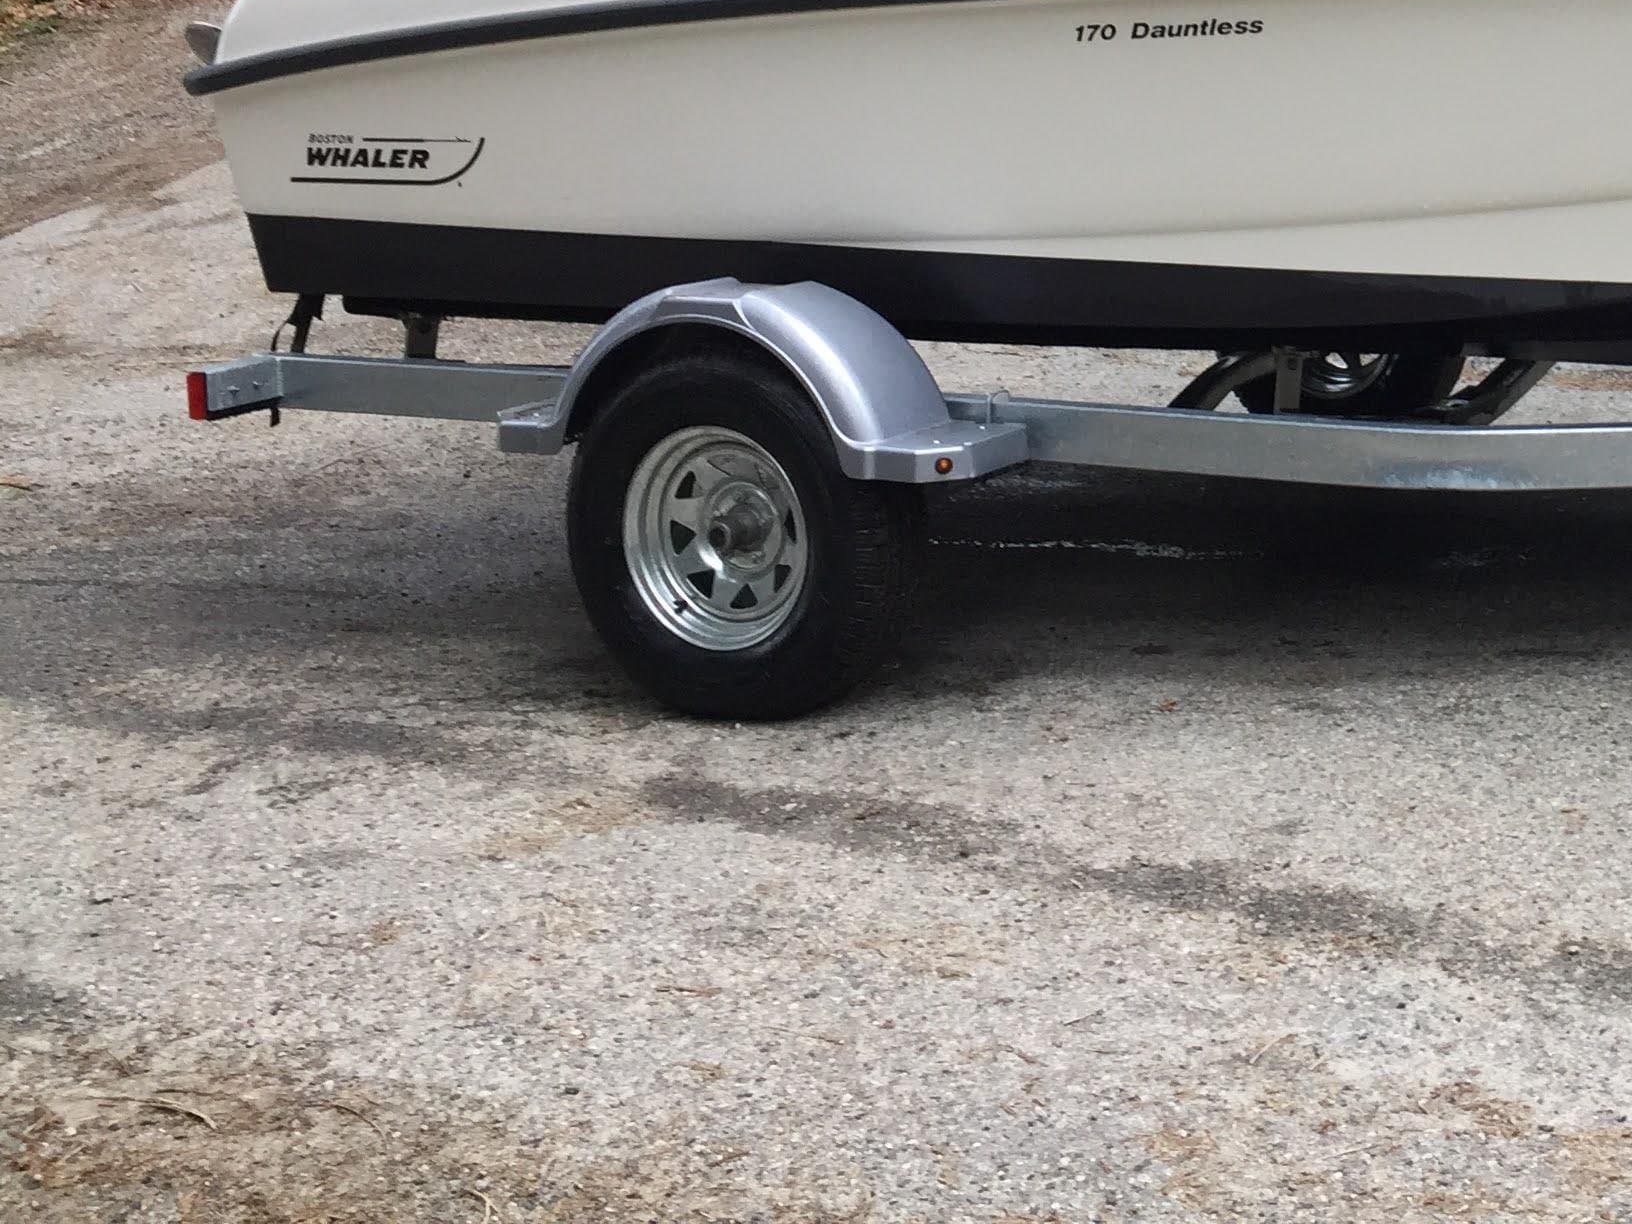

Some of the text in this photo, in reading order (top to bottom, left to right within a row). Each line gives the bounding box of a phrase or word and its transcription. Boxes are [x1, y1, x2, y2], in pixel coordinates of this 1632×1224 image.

[1074, 18, 1265, 43] 170 Dauntless
[307, 133, 355, 145] BOSTON
[306, 146, 431, 169] WHALER
